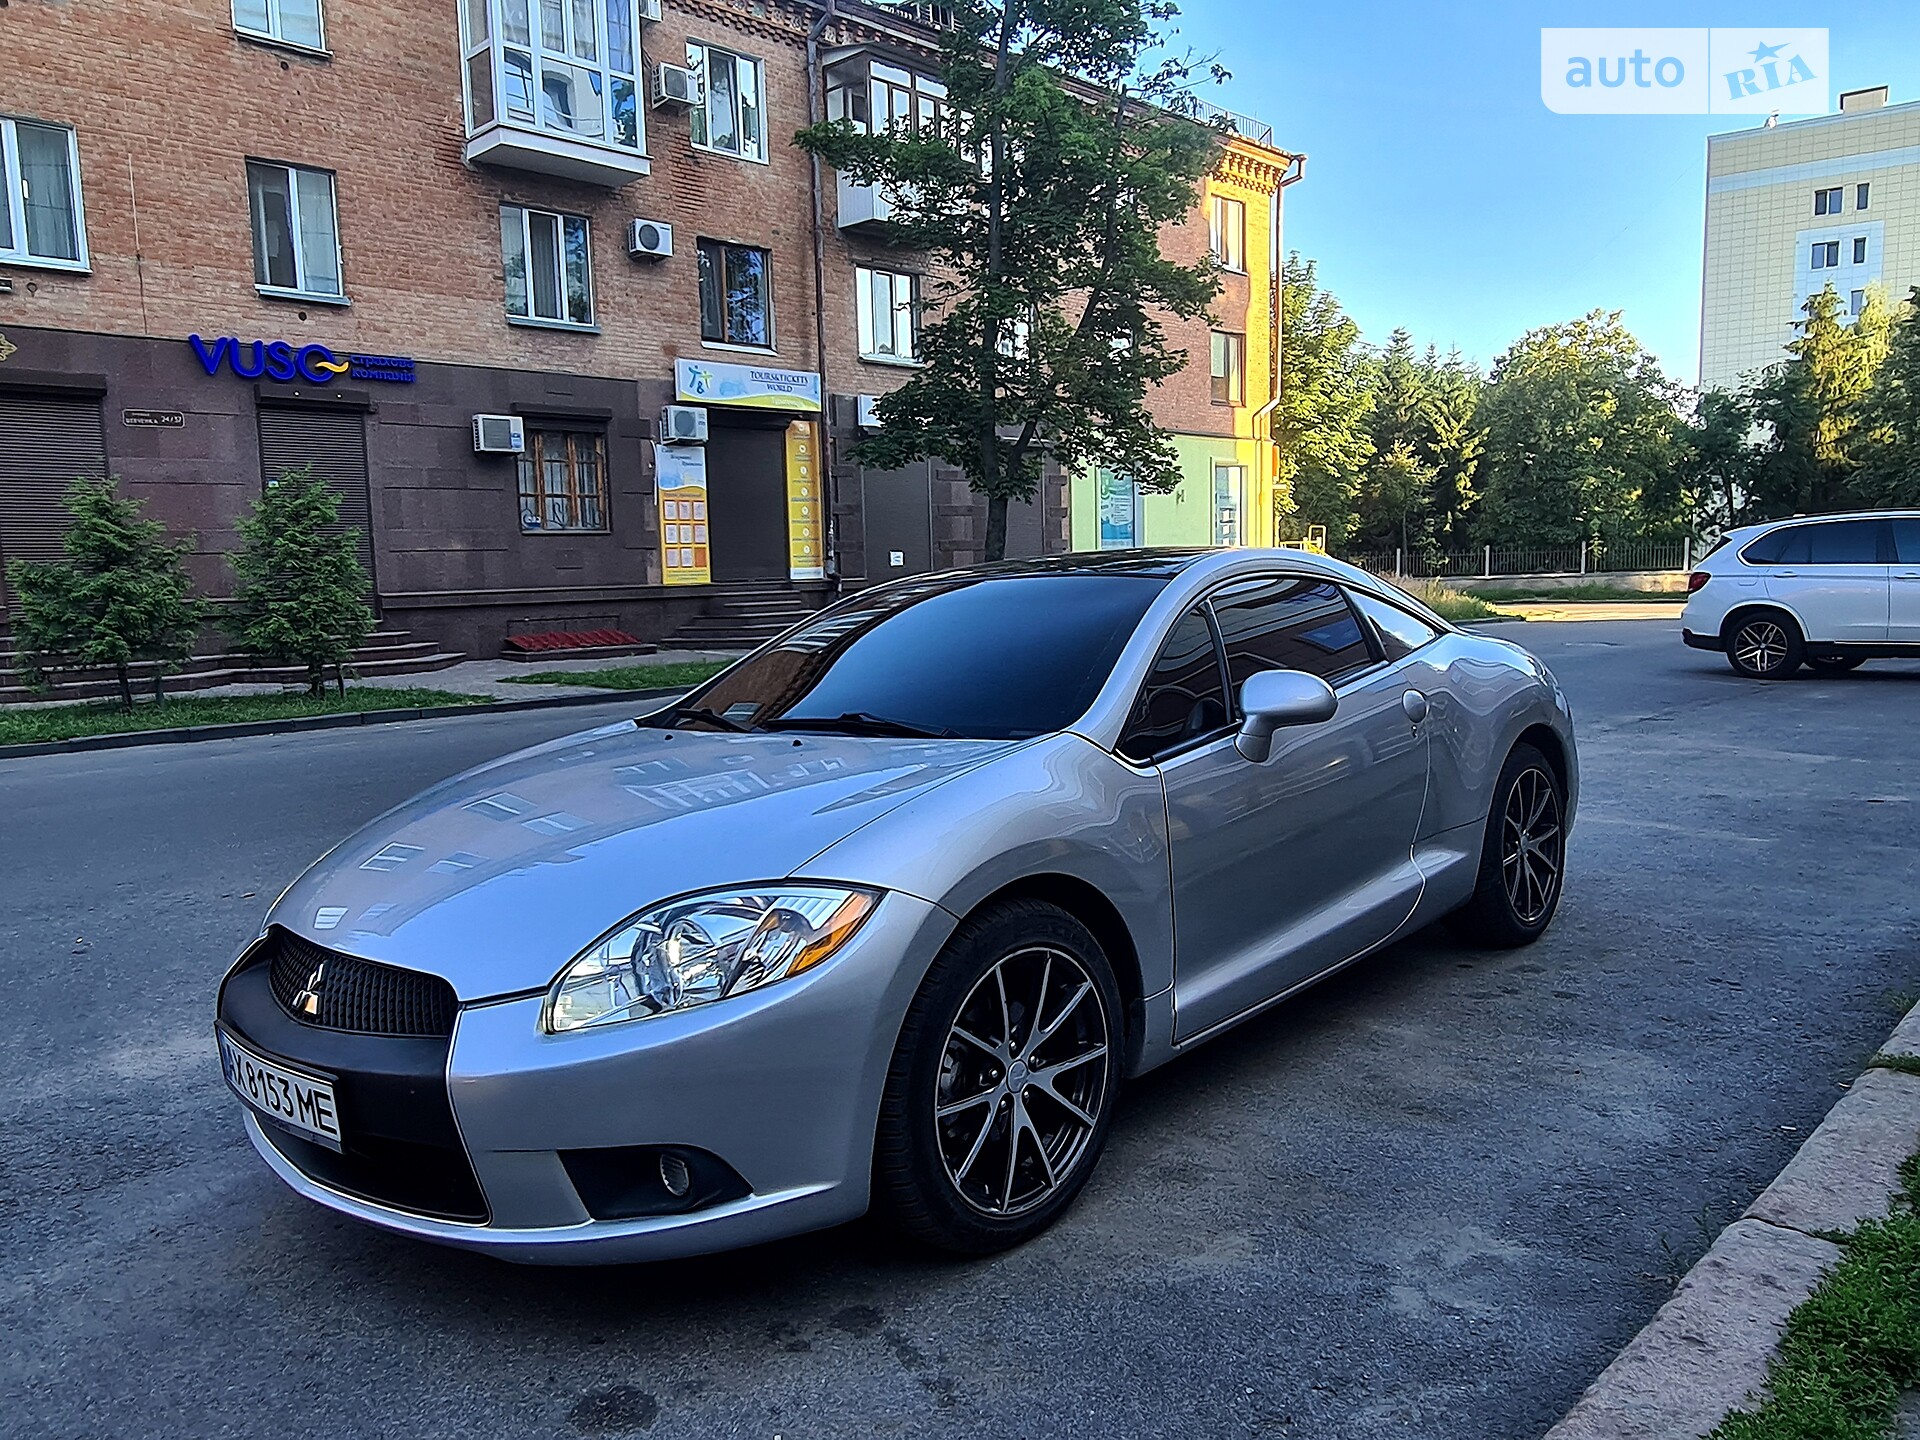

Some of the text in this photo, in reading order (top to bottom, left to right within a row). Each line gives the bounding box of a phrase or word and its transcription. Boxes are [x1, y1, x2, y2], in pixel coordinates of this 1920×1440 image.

[351, 368, 416, 382] компанія
[766, 383, 793, 393] WORLD
[246, 1061, 294, 1118] 8153
[295, 1082, 338, 1135] ME
